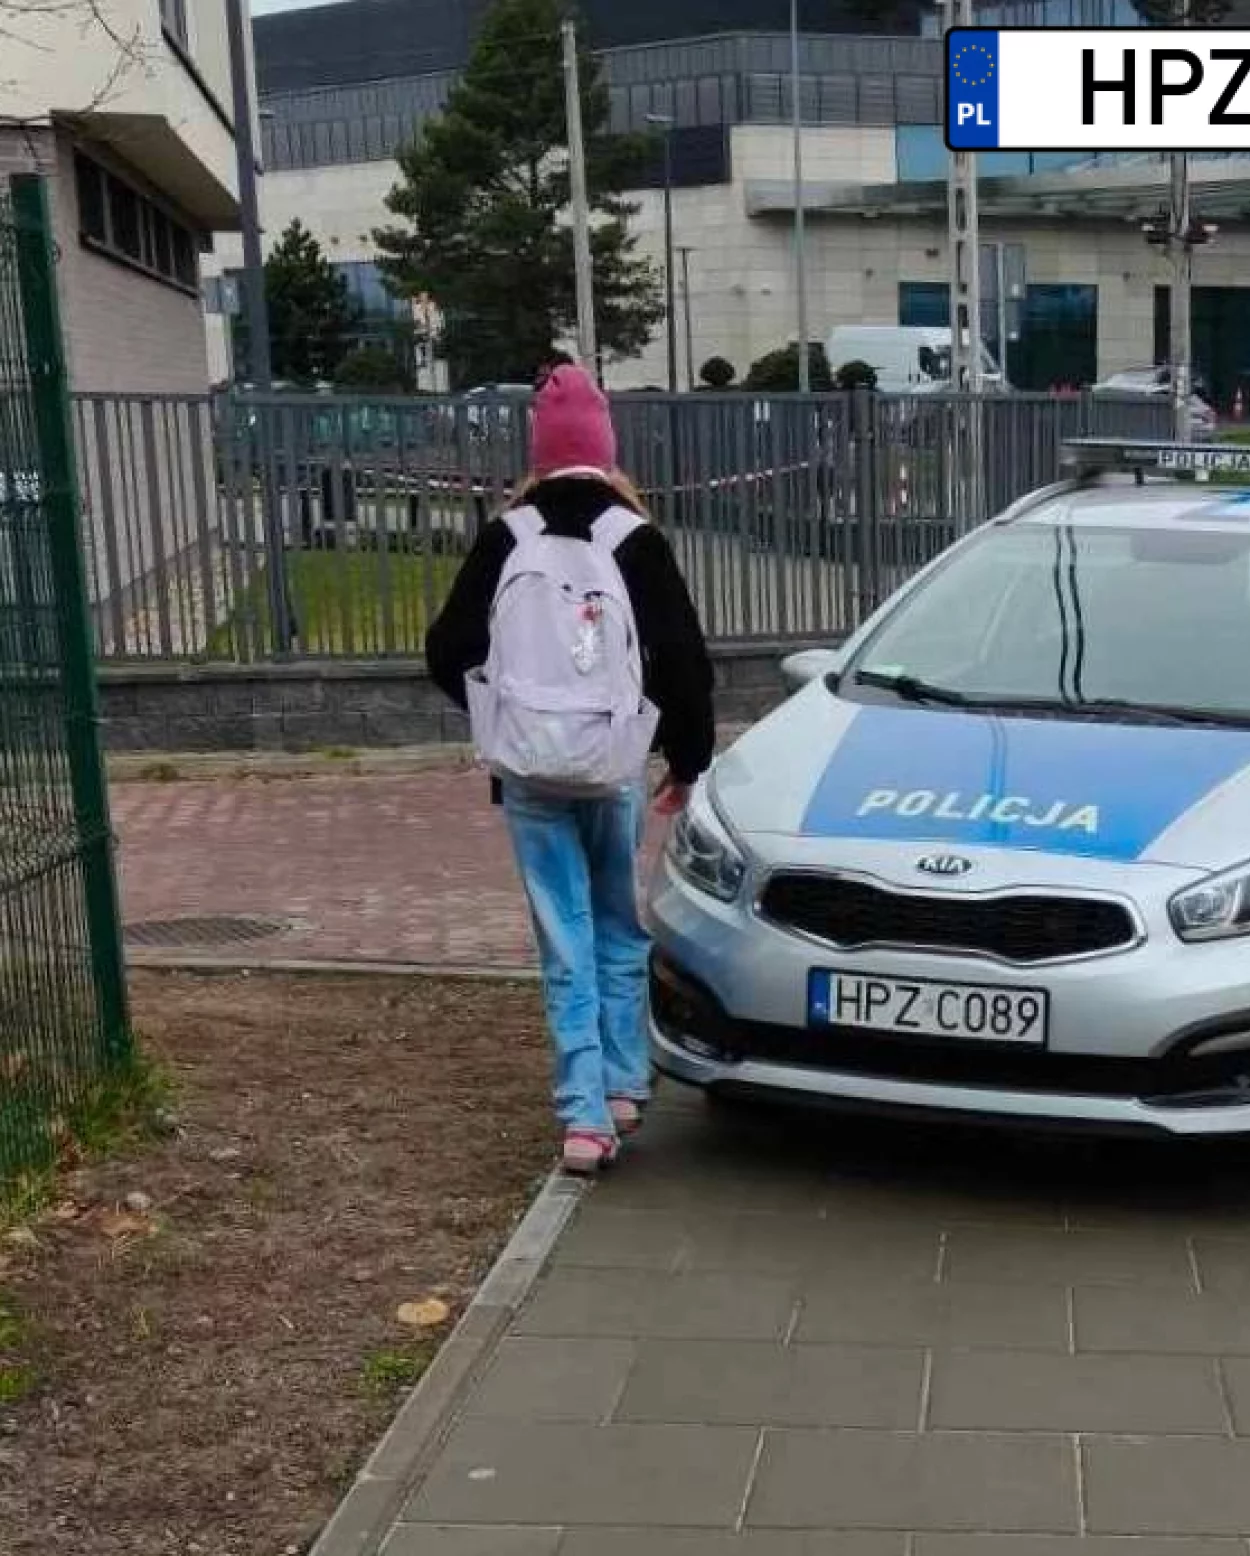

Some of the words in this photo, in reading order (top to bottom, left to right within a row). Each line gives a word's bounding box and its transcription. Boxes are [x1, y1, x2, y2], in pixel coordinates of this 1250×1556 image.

[856, 789, 1101, 835] POLICJA
[919, 855, 971, 875] KIA
[837, 977, 922, 1028] HPZ
[937, 989, 1040, 1038] C089
